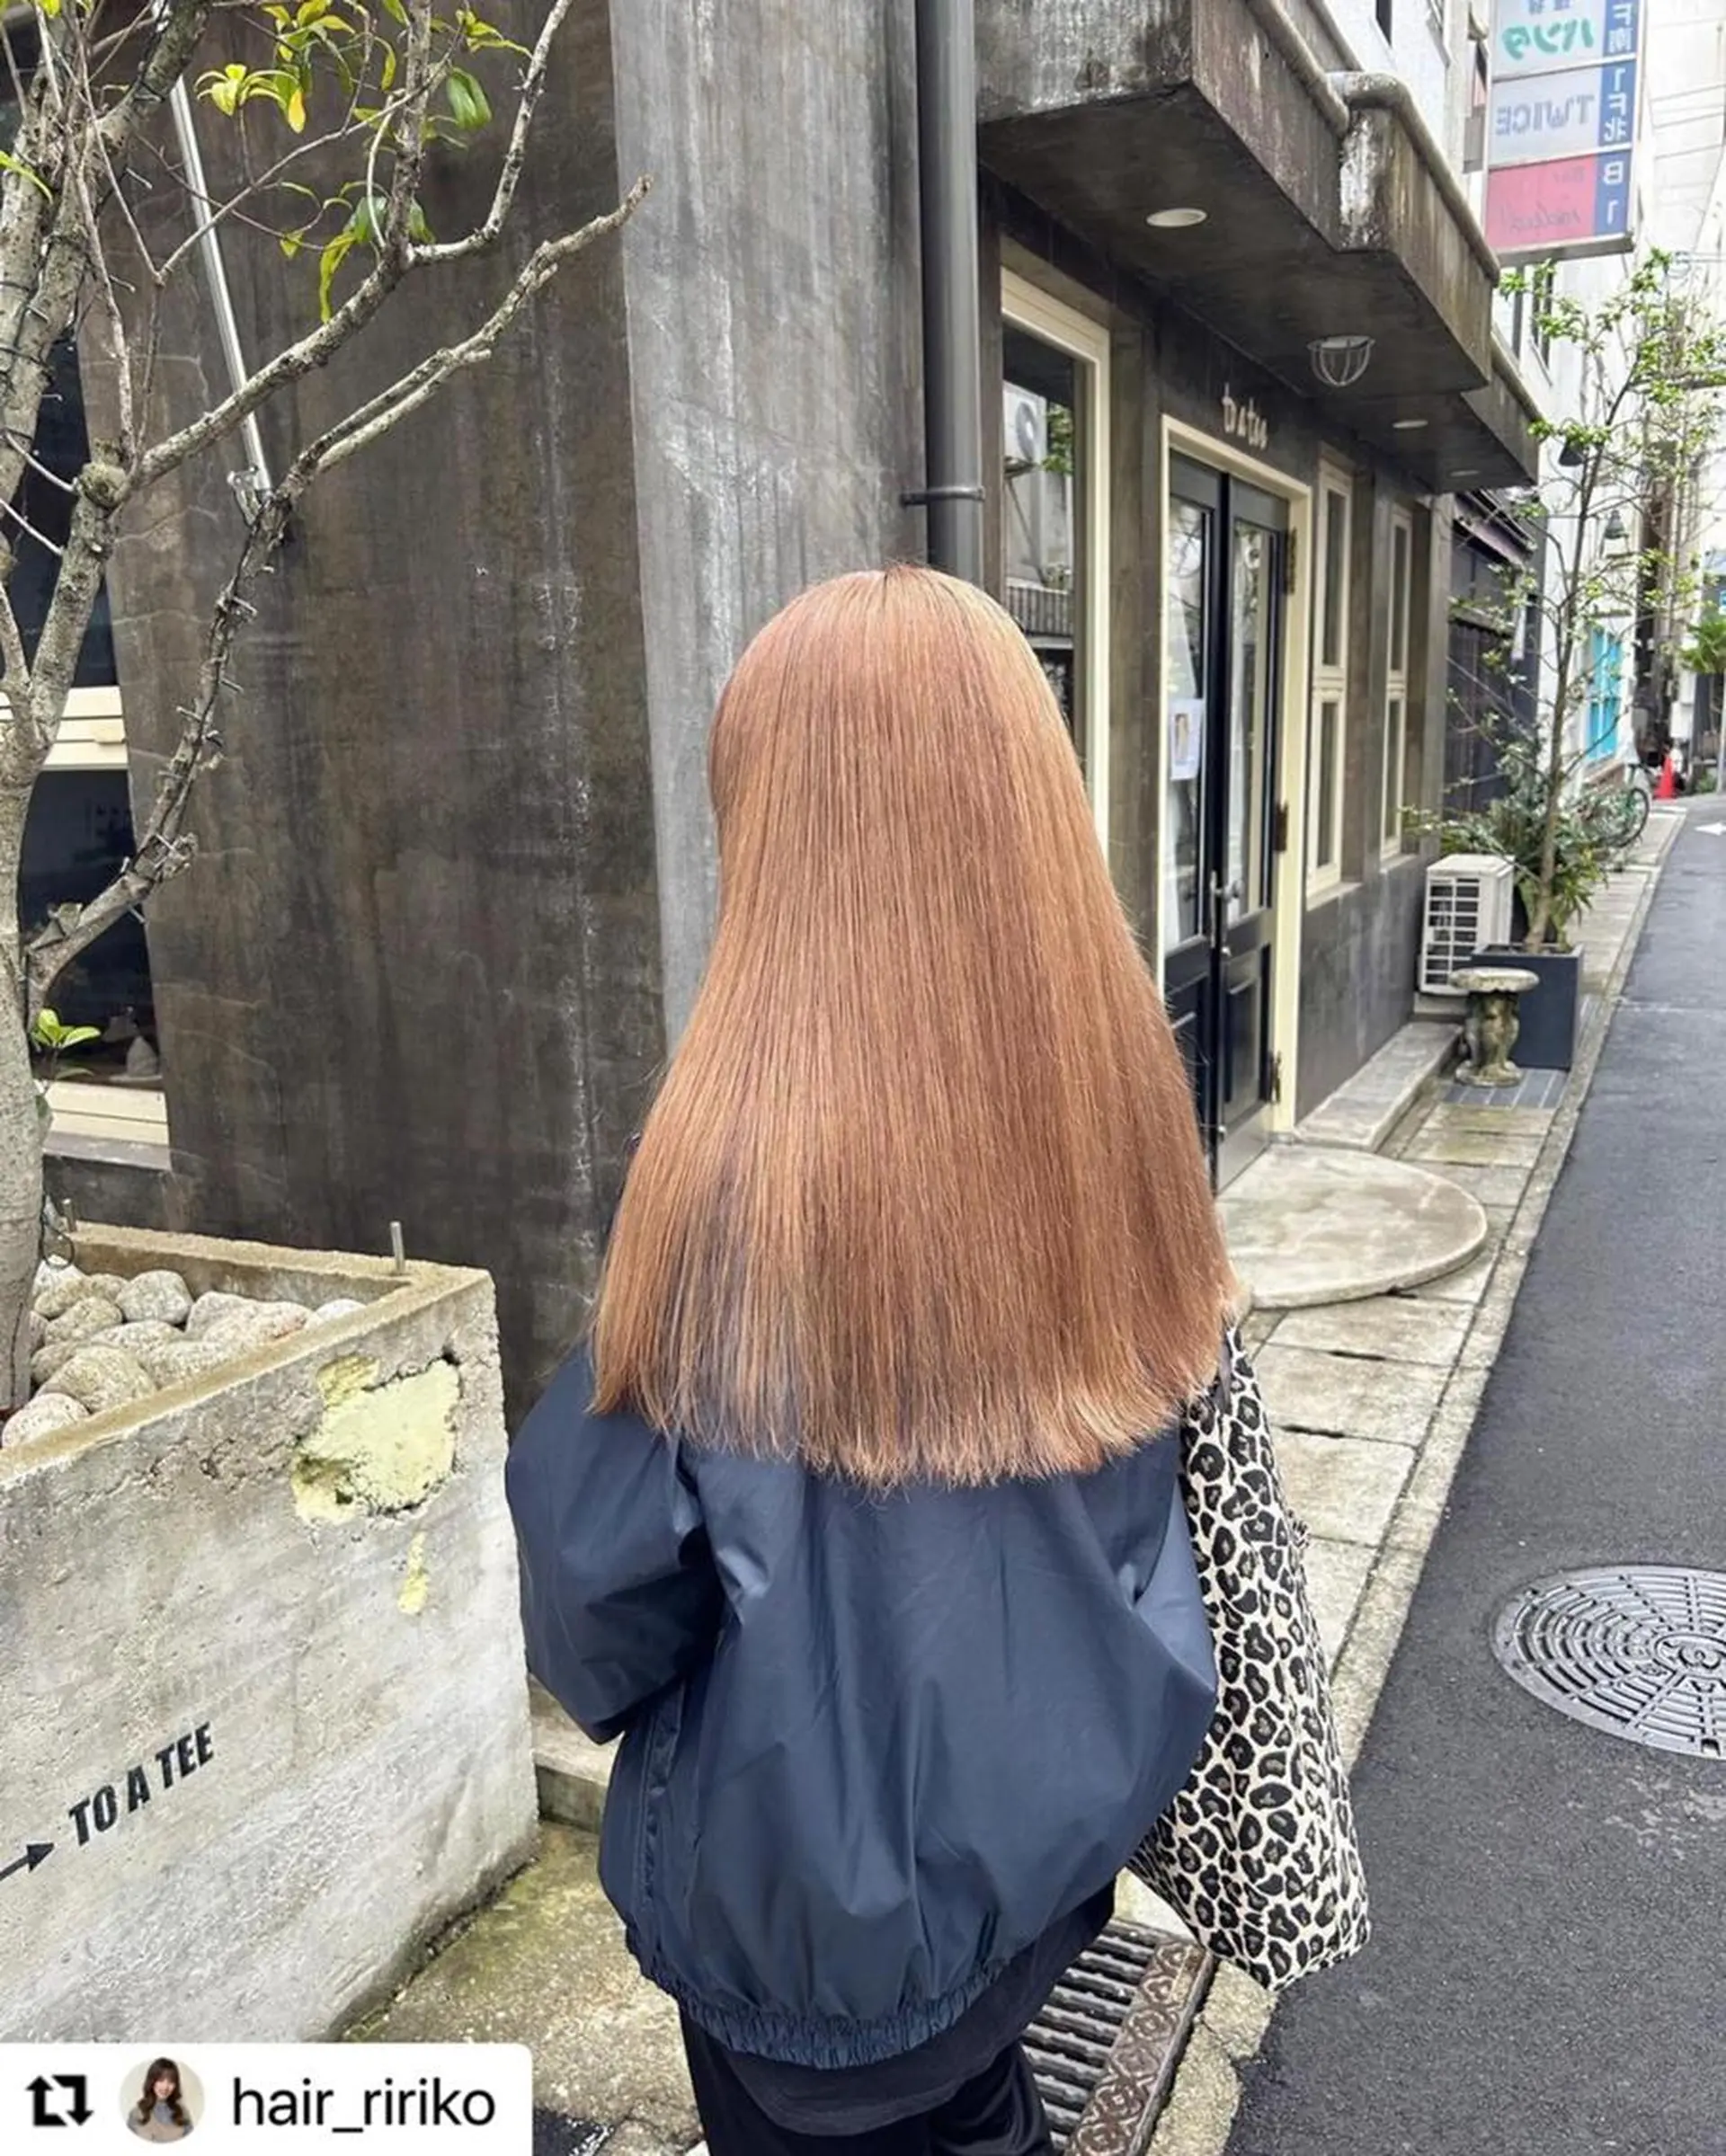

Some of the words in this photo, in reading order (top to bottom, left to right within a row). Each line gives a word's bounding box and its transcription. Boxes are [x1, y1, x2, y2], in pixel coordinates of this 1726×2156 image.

[68, 1785, 118, 1847] TO
[128, 1765, 151, 1813] A
[156, 1721, 214, 1789] TEE
